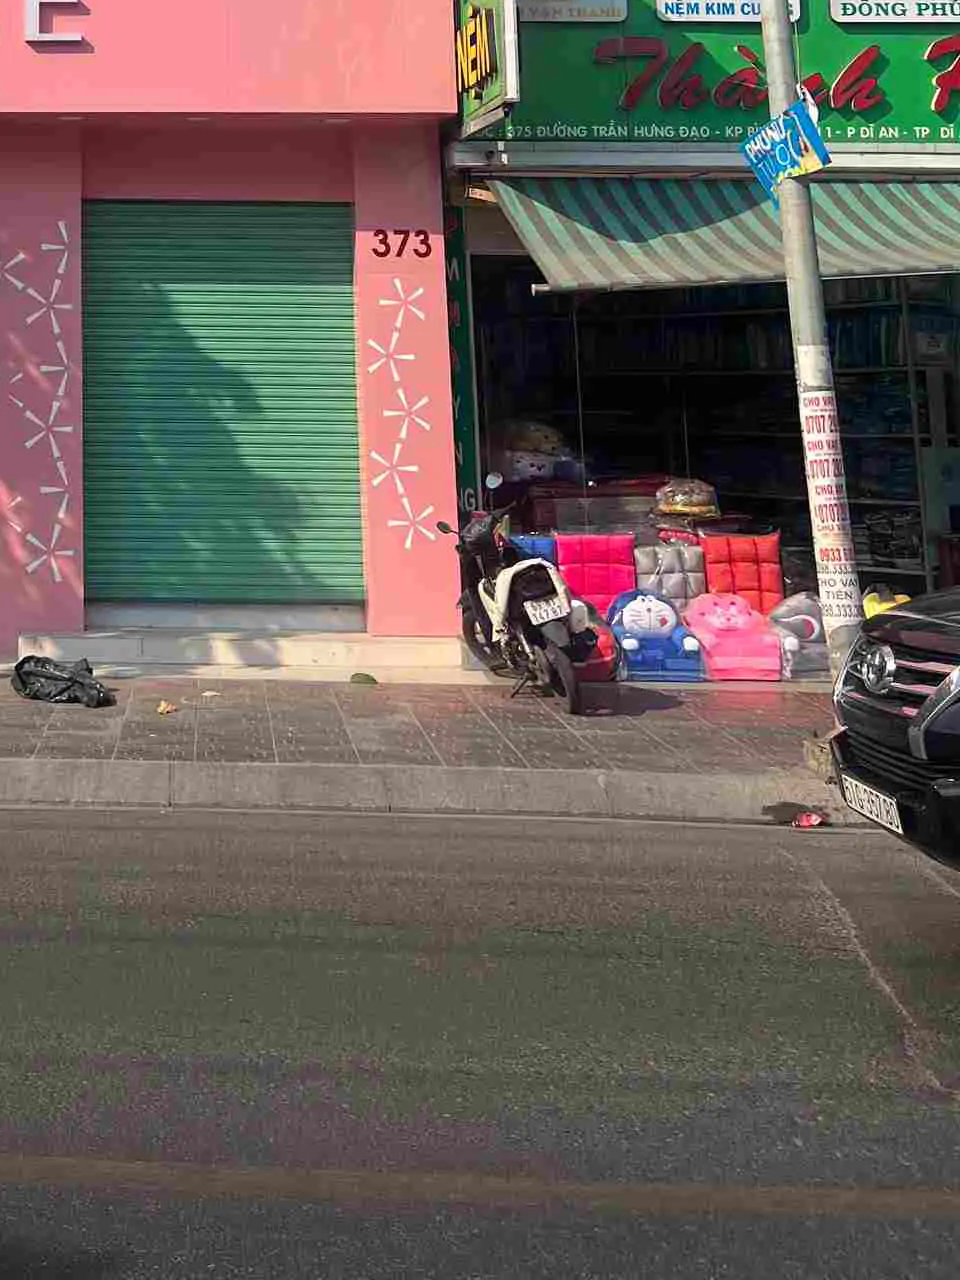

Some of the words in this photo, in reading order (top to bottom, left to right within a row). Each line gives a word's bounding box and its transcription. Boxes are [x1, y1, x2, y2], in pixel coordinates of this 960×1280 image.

[664, 0, 700, 17] NỆM
[706, 2, 736, 16] KIM
[879, 127, 899, 138] AN
[913, 126, 930, 139] TP
[372, 229, 432, 258] 373
